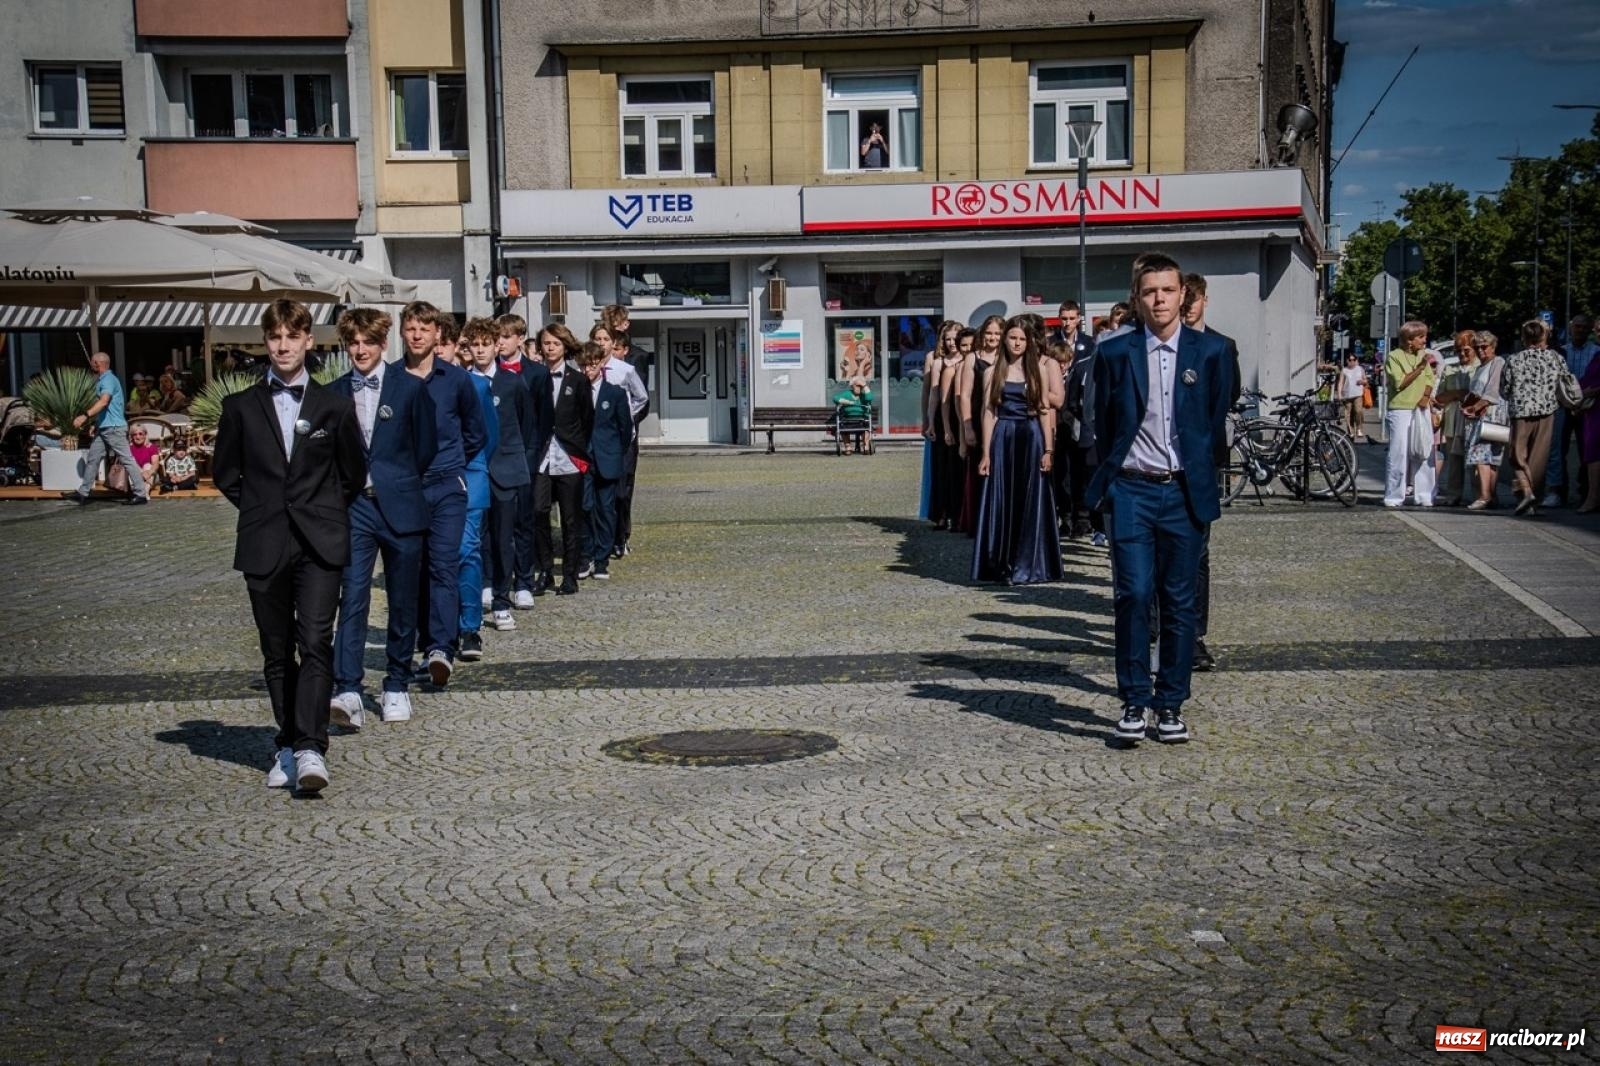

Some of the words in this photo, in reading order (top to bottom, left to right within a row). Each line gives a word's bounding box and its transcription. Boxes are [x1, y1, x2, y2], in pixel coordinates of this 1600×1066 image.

[647, 194, 693, 212] TEB
[931, 178, 1160, 215] ROSSMANN
[647, 215, 694, 223] EDUKACJA
[673, 341, 701, 353] TEB
